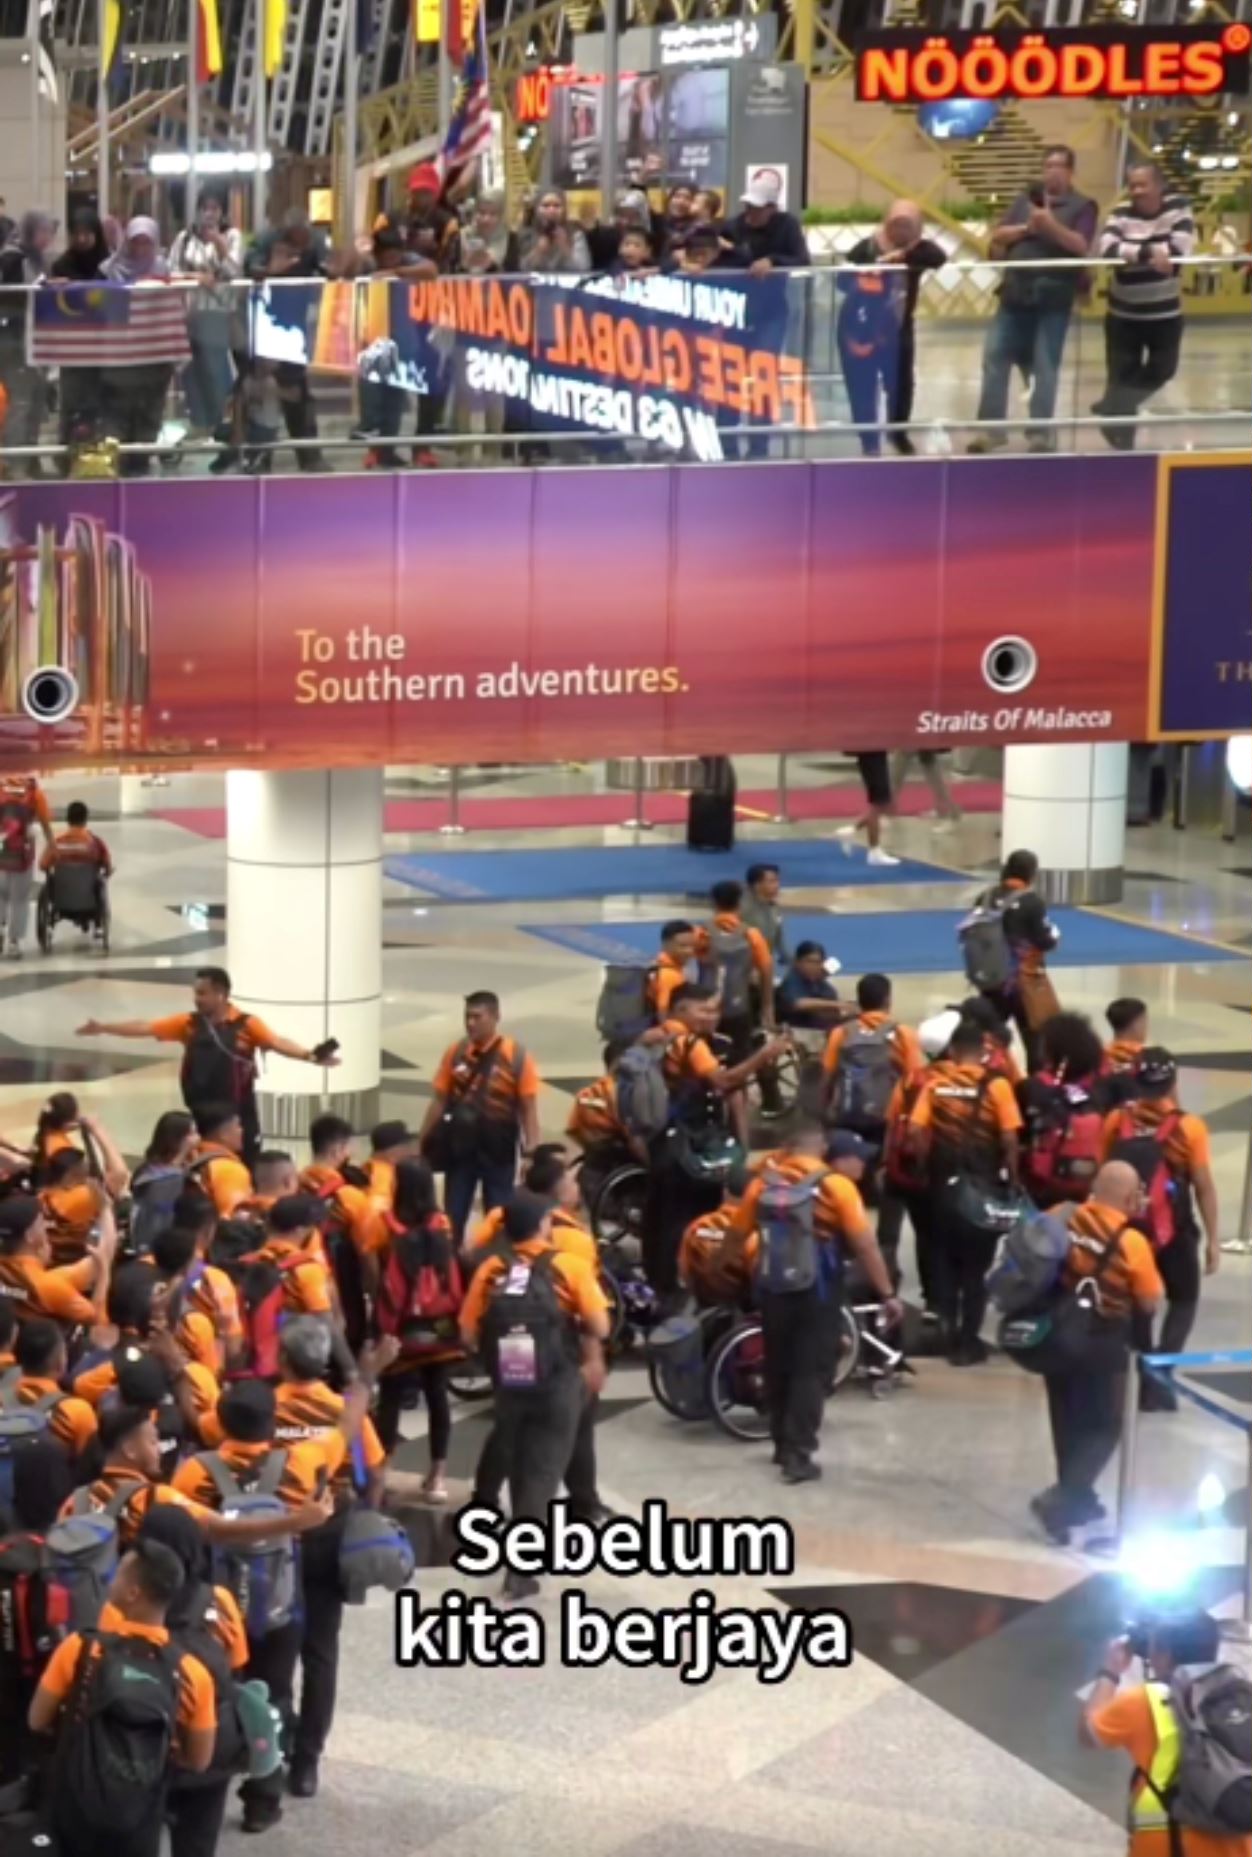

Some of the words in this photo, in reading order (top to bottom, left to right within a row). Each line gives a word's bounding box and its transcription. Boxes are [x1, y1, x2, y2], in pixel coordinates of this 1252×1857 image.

[862, 35, 1224, 100] NÖÖÖDLES
[295, 629, 335, 663] To
[346, 625, 406, 660] the
[295, 666, 465, 704] Southern
[476, 661, 690, 698] adventures.
[916, 710, 988, 733] Straits
[993, 708, 1022, 730] Of
[1024, 706, 1112, 730] Malacca
